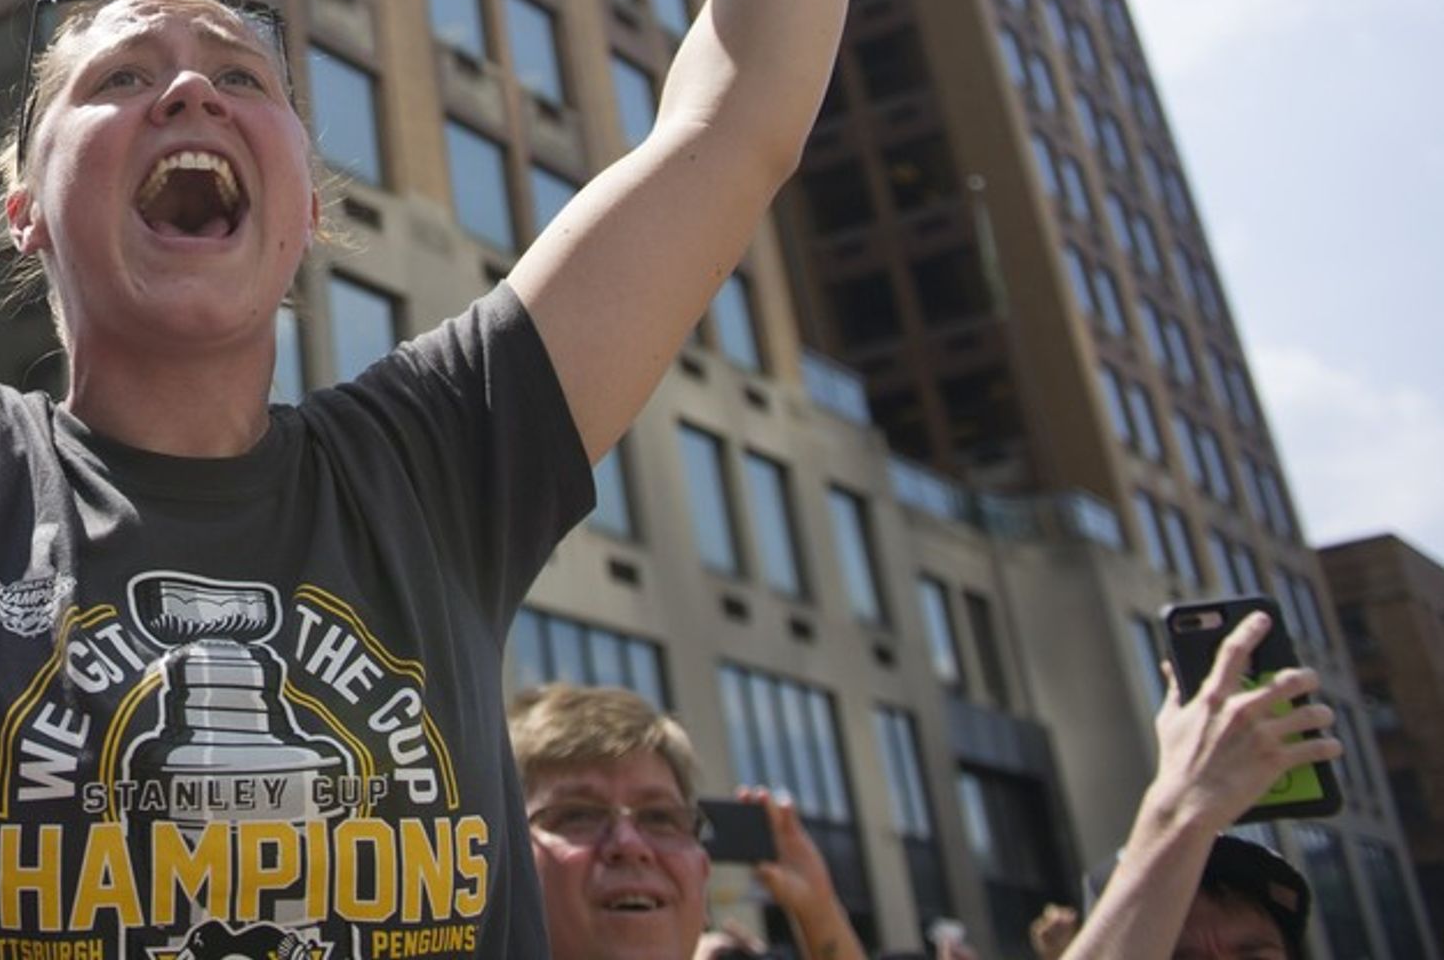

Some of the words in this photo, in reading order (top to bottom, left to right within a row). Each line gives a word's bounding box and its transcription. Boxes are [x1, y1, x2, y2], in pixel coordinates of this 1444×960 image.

[17, 701, 91, 802] WE
[296, 604, 385, 705] THE
[367, 687, 439, 804] CUP
[82, 776, 289, 813] STANLEY
[311, 774, 387, 807] CUP
[371, 925, 476, 959] PENGUINS
